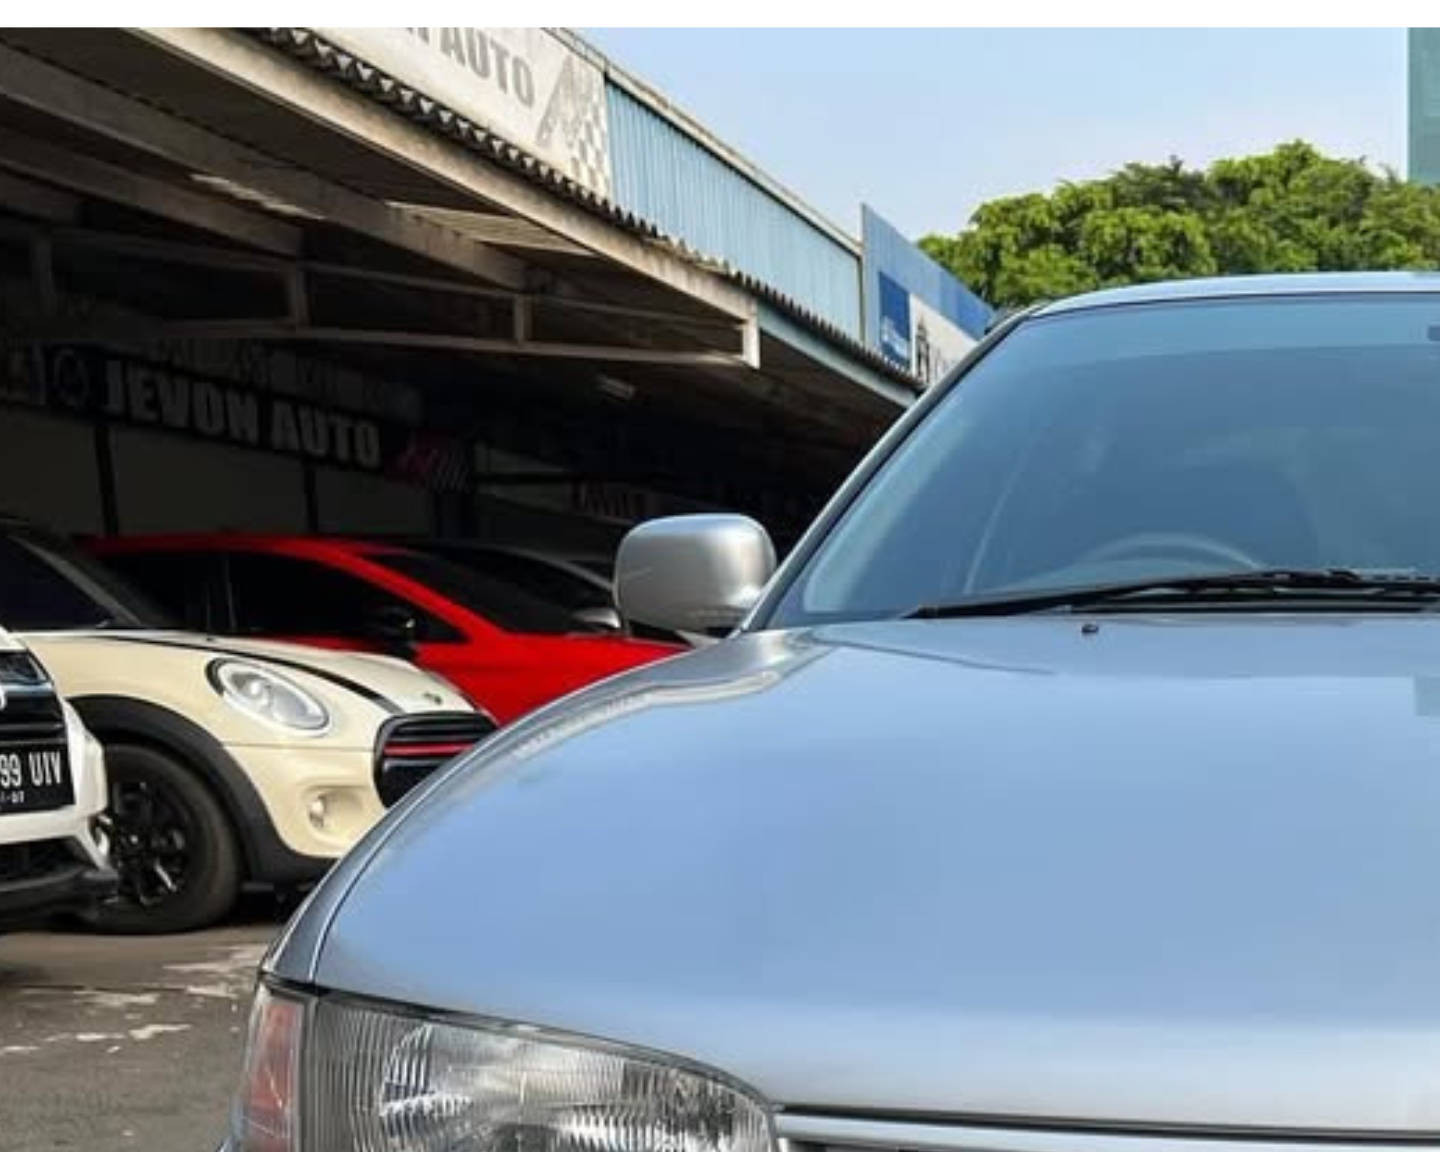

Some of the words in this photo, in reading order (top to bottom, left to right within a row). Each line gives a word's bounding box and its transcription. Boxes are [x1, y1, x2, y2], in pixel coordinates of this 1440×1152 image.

[440, 28, 535, 108] AUTO
[103, 358, 260, 446] JEVON
[271, 400, 383, 469] AUTO
